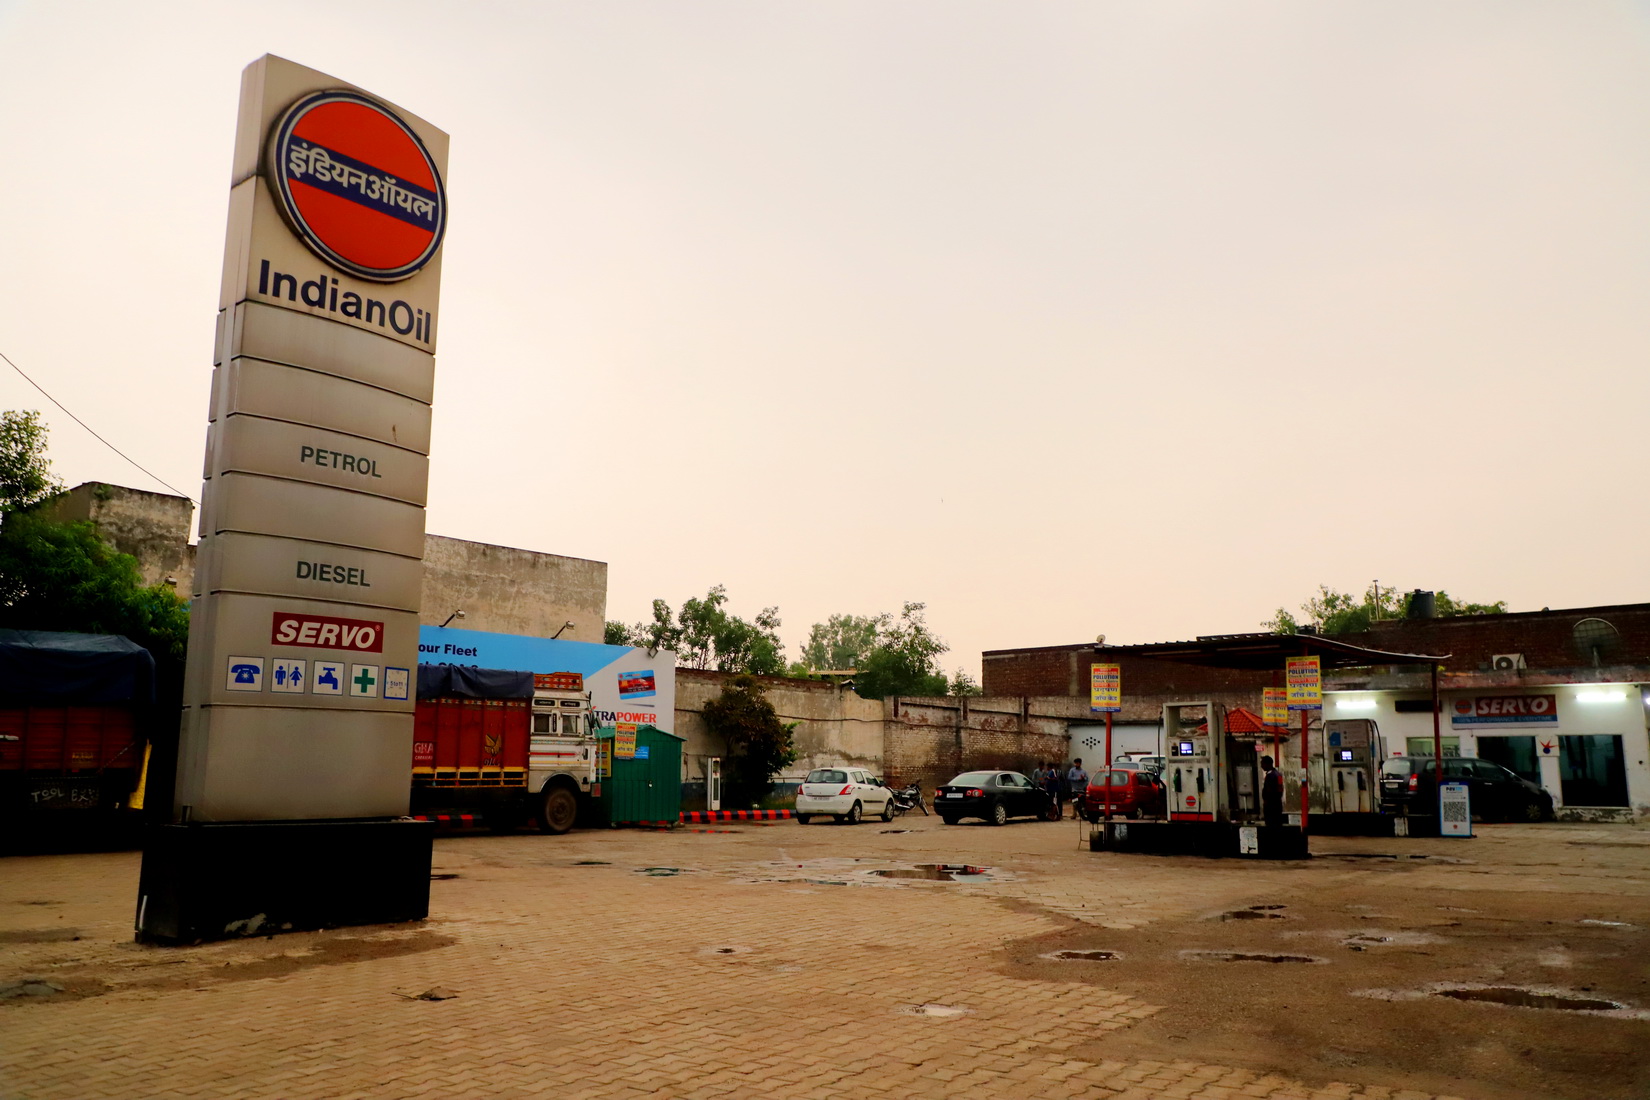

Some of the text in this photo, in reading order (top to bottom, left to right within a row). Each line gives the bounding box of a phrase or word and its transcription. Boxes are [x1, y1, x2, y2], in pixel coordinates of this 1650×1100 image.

[289, 142, 436, 221] इंडियनऑयल
[258, 259, 431, 344] IndianOil
[301, 446, 382, 478] PETROL
[296, 560, 370, 587] DIESEL
[444, 644, 477, 656] Fleet
[1477, 697, 1548, 714] SERVO
[31, 788, 65, 803] TOOL
